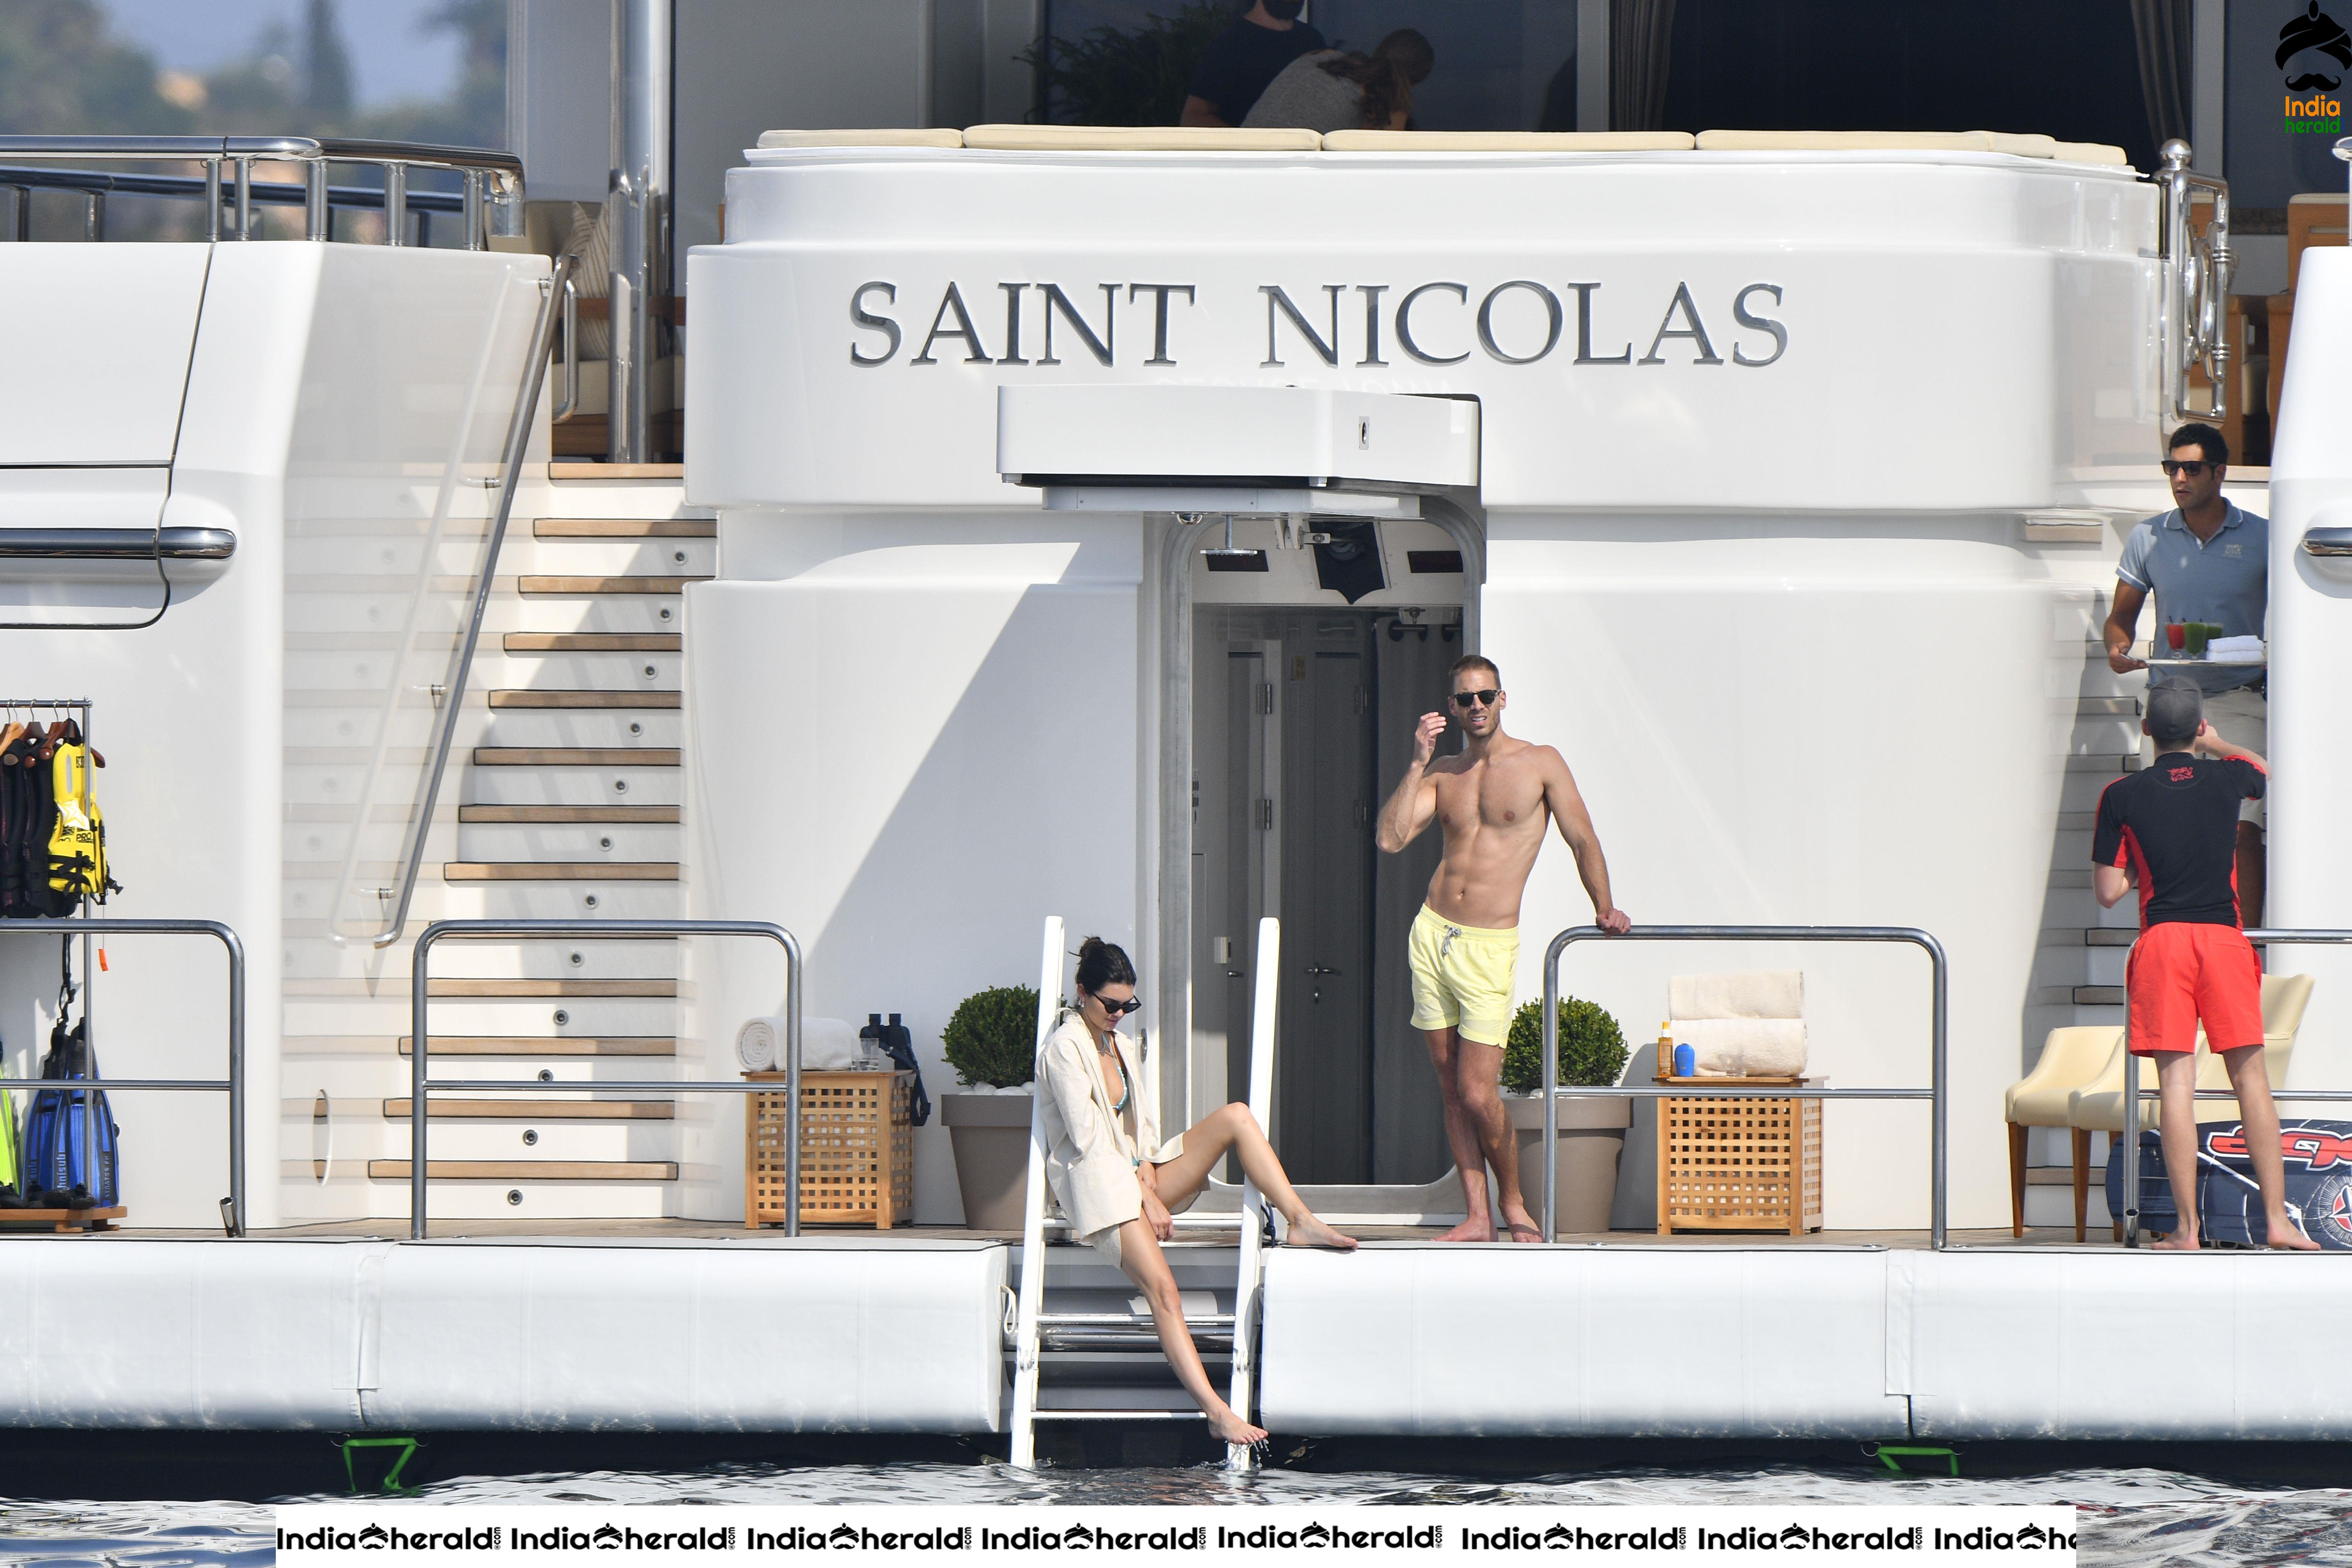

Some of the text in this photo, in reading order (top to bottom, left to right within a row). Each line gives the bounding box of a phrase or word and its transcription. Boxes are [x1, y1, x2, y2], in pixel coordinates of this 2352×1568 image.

[849, 280, 1788, 368] SAINT NICOLAS
[56, 1153, 66, 1189] hnisub
